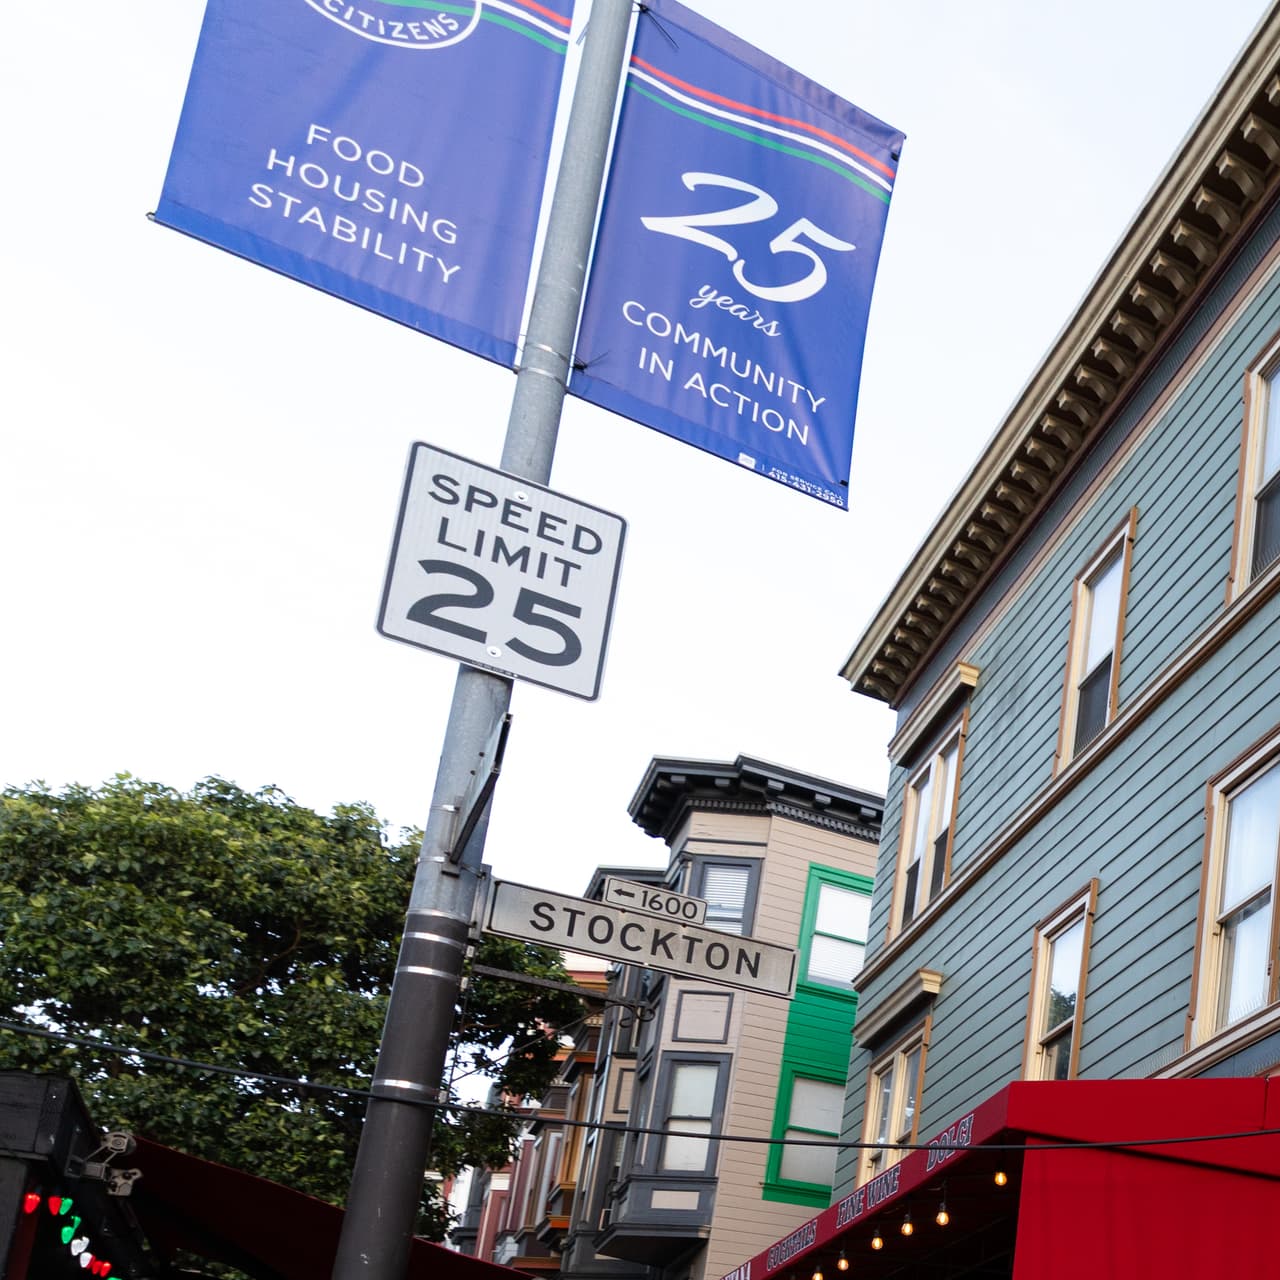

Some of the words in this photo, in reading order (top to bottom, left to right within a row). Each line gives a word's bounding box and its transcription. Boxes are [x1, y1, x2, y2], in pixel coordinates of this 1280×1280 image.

[323, 0, 460, 41] CITIZENS
[306, 123, 426, 189] FOOD
[248, 183, 462, 285] STABILITY
[266, 148, 459, 247] HOUSING
[639, 170, 857, 304] 25
[687, 280, 783, 339] years
[621, 300, 827, 415] COMMUNITY
[637, 345, 676, 381] IN
[683, 369, 810, 446] ACTION
[427, 472, 604, 556] SPEED
[437, 515, 583, 589] LIMIT
[405, 558, 584, 668] 25
[529, 901, 762, 979] STOCKTON
[641, 889, 699, 920] 1600
[926, 1113, 974, 1172] DOLCI
[836, 1187, 865, 1230] FINE
[866, 1164, 901, 1210] WINE
[766, 1219, 818, 1272] COCKTAILS
